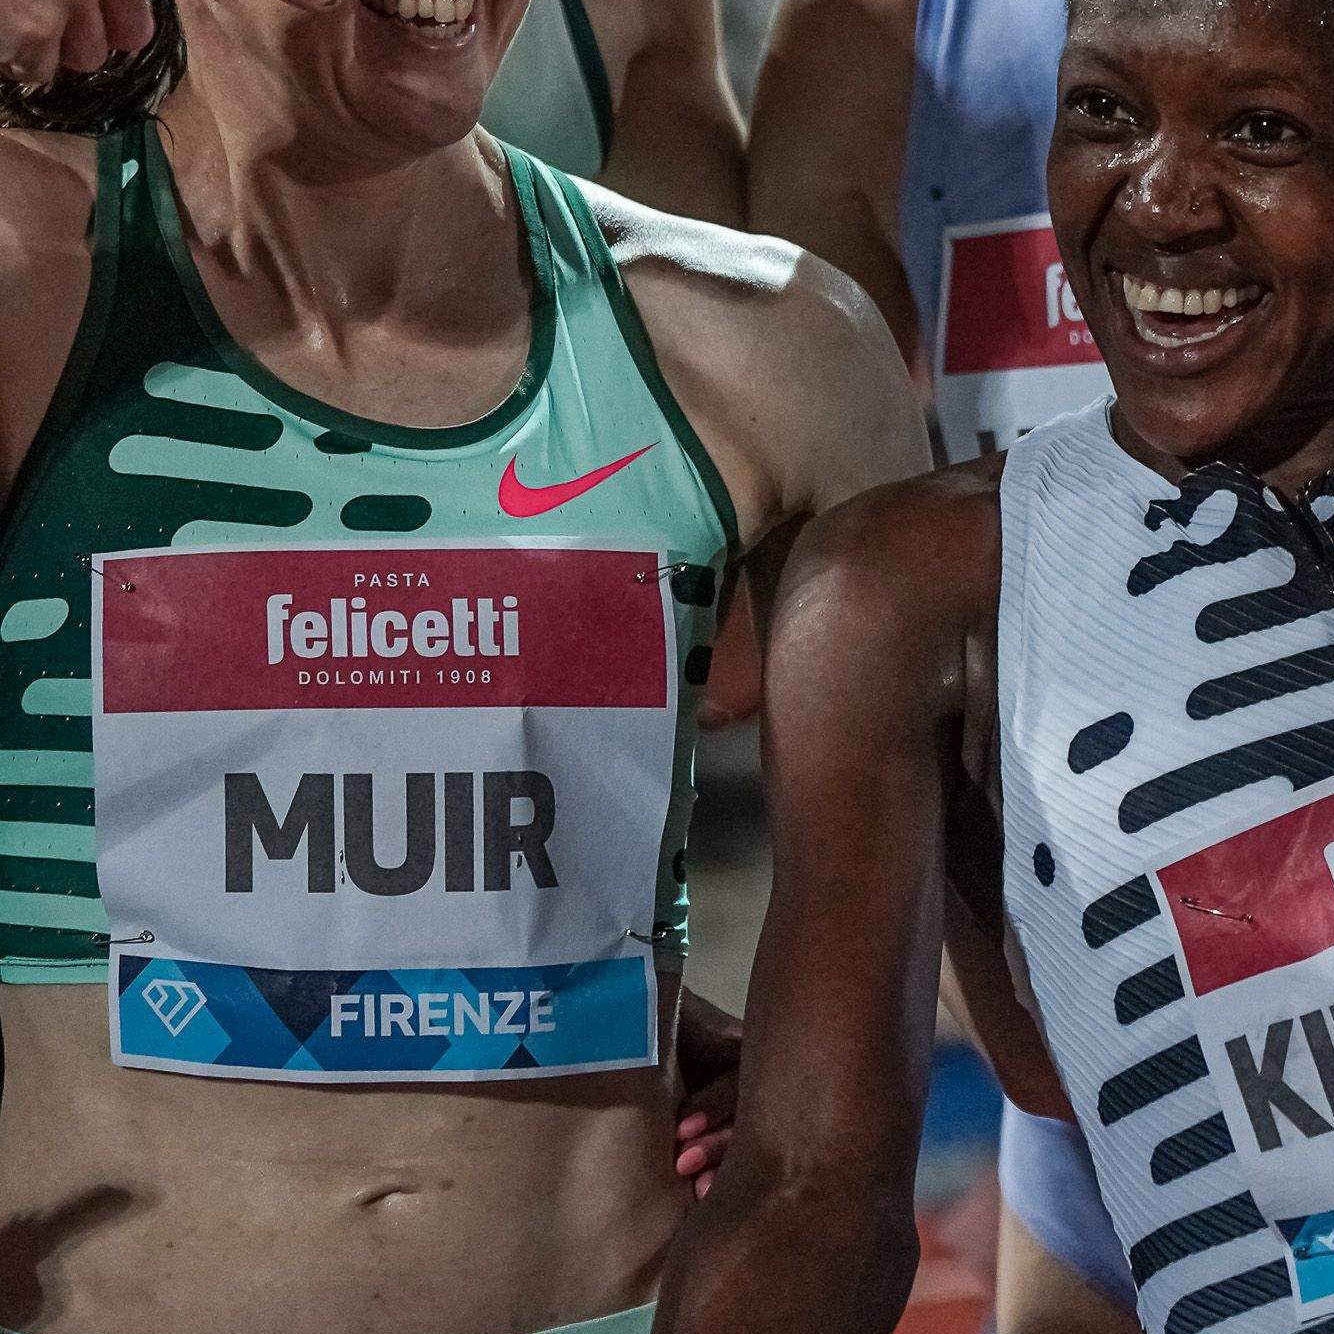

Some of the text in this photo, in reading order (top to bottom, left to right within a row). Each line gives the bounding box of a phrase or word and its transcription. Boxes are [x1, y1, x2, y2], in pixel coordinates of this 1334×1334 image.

[354, 573, 430, 587] PASTA
[267, 593, 520, 665] felicetti
[299, 669, 492, 685] DOLOMITI 1908
[224, 770, 559, 896] MUIR
[330, 990, 555, 1037] FIRENZE
